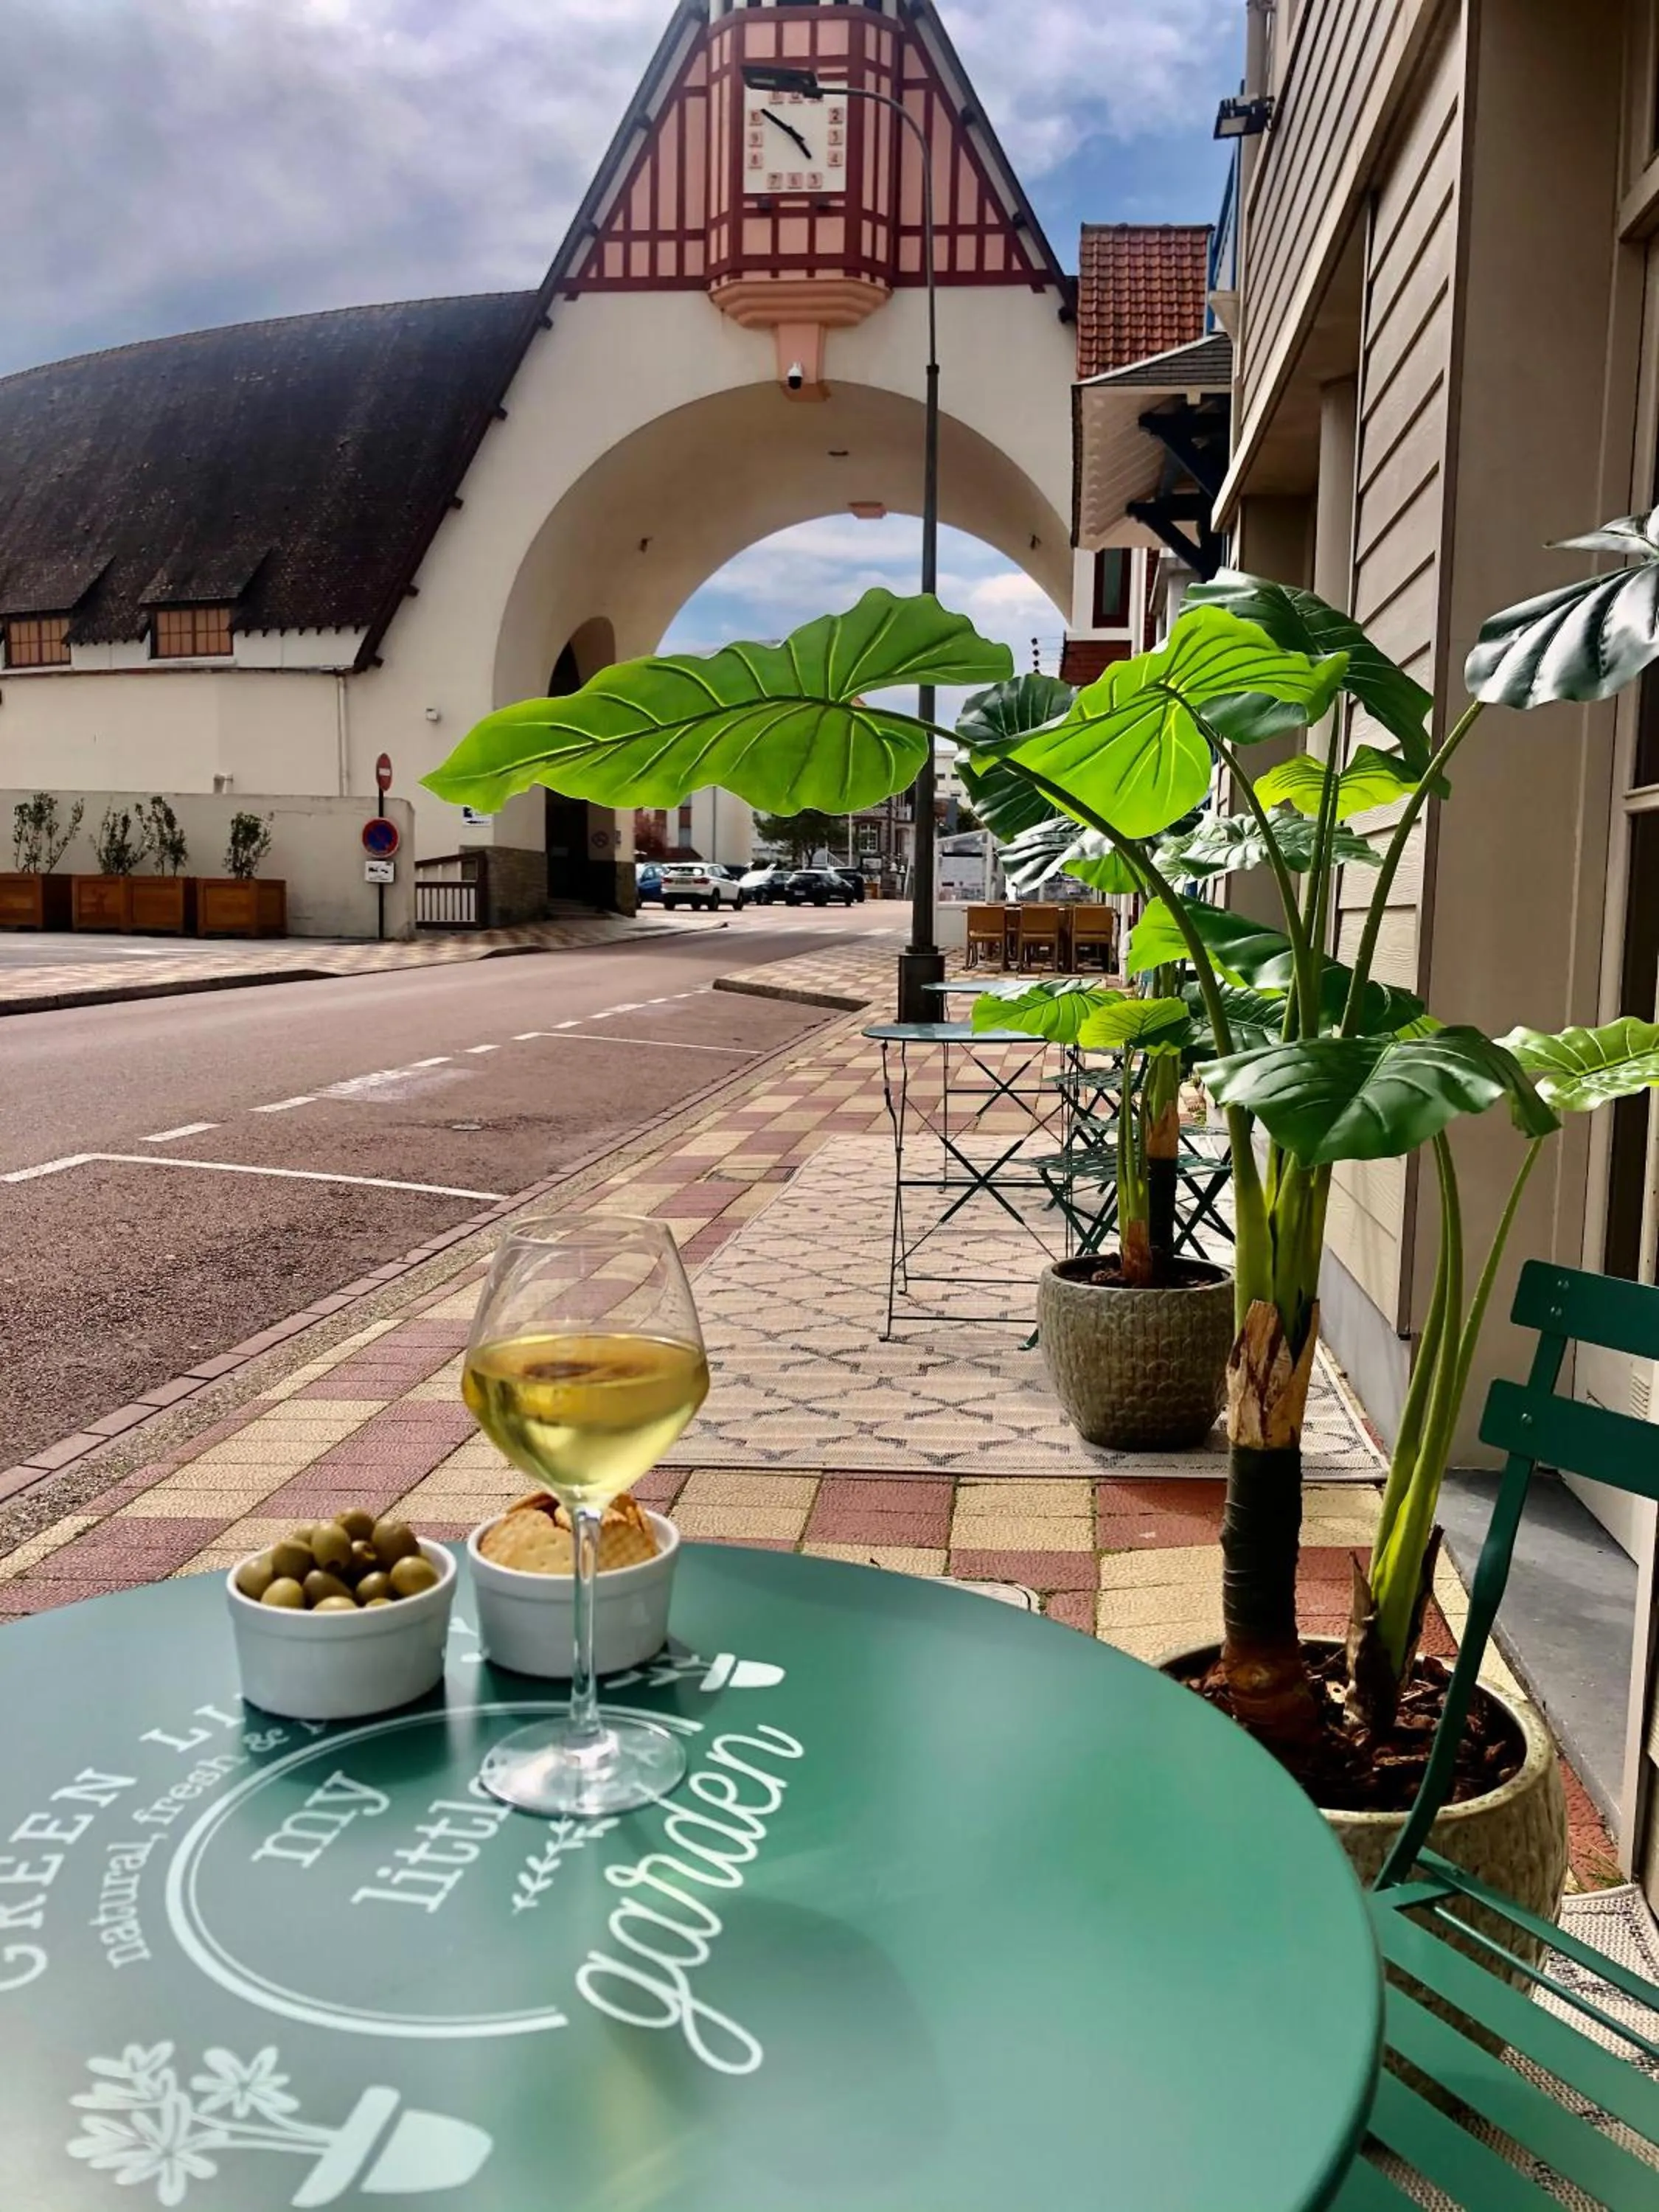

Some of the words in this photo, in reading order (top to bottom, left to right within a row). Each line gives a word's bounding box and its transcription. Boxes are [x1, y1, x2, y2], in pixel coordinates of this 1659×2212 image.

[131, 1754, 250, 1826] fresh
[251, 1770, 391, 1869] my
[575, 1723, 805, 2076] garden
